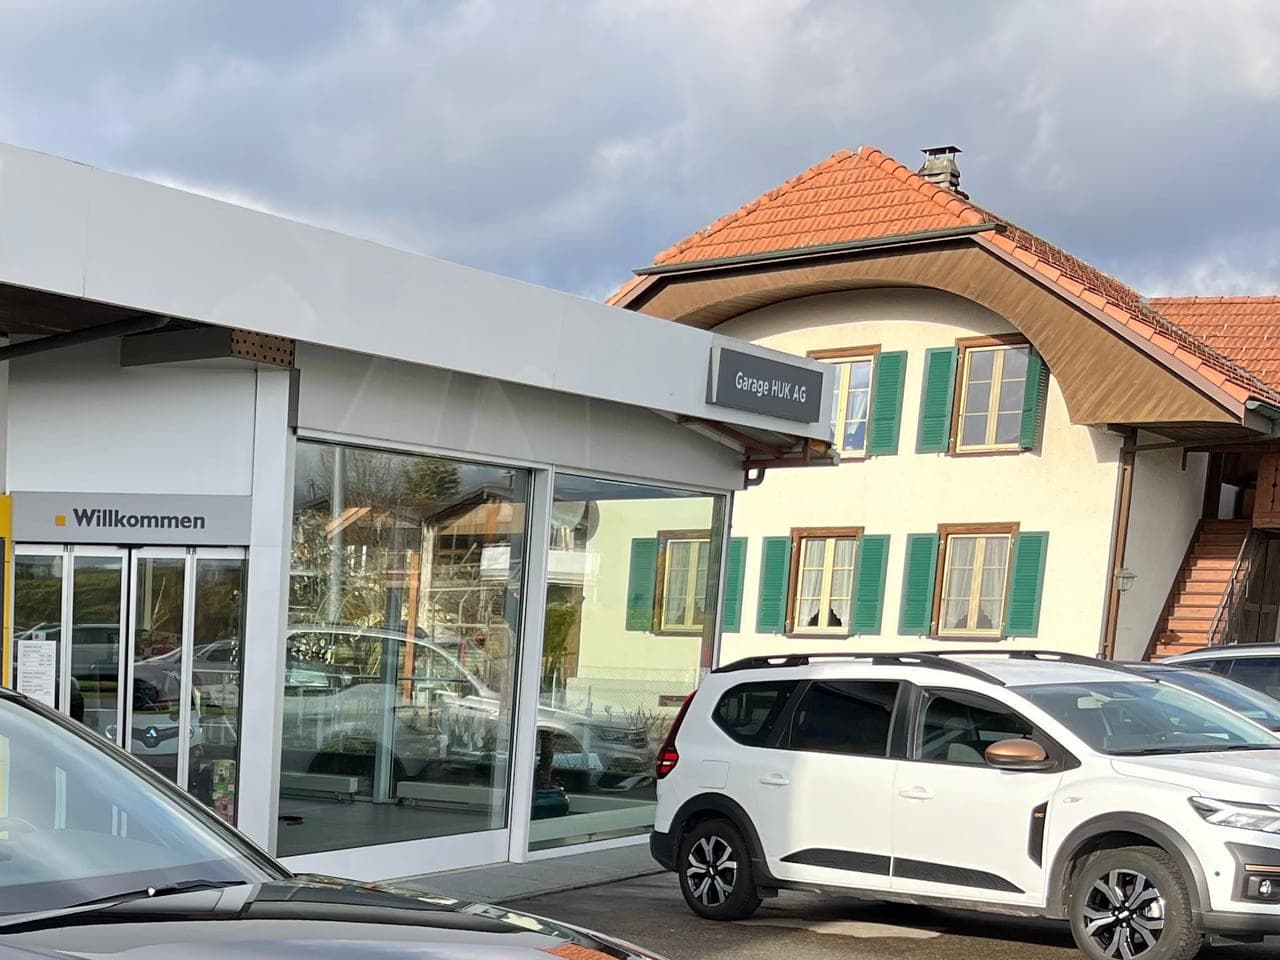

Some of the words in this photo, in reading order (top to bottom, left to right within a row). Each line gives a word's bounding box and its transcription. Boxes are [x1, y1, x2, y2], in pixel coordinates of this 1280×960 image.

[735, 371, 769, 396] Garage
[771, 379, 791, 400] HUK
[792, 384, 807, 403] AG
[73, 508, 206, 529] Willkommen
